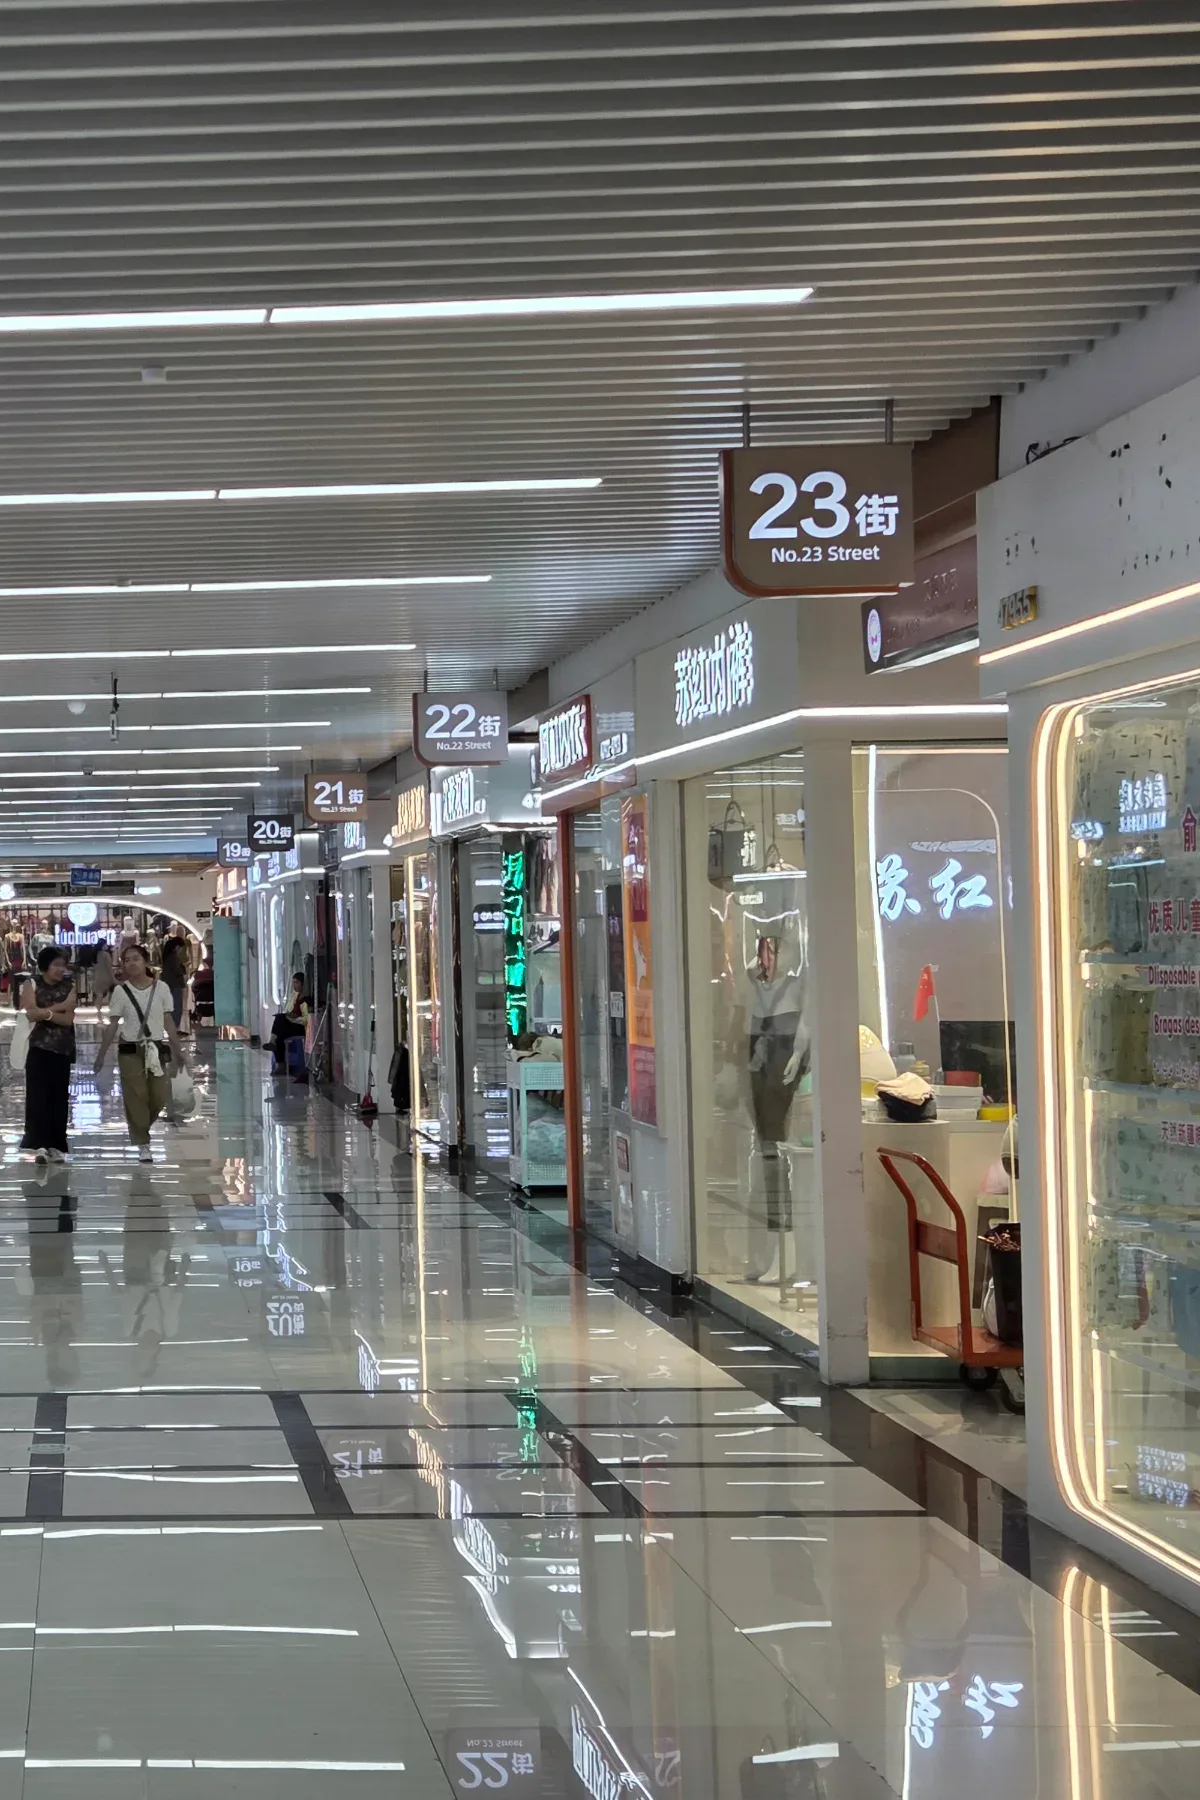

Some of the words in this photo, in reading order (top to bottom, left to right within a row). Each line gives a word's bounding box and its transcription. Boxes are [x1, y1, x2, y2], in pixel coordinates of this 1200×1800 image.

[749, 471, 899, 540] 23街
[771, 547, 822, 563] No.23
[827, 545, 880, 561] Street
[425, 704, 500, 738] 22街
[436, 741, 462, 750] No.22
[465, 741, 491, 750] Street
[313, 781, 364, 805] 21街
[253, 820, 292, 838] 20街
[877, 853, 993, 921] 苏红
[1154, 1014, 1182, 1040] Bragas
